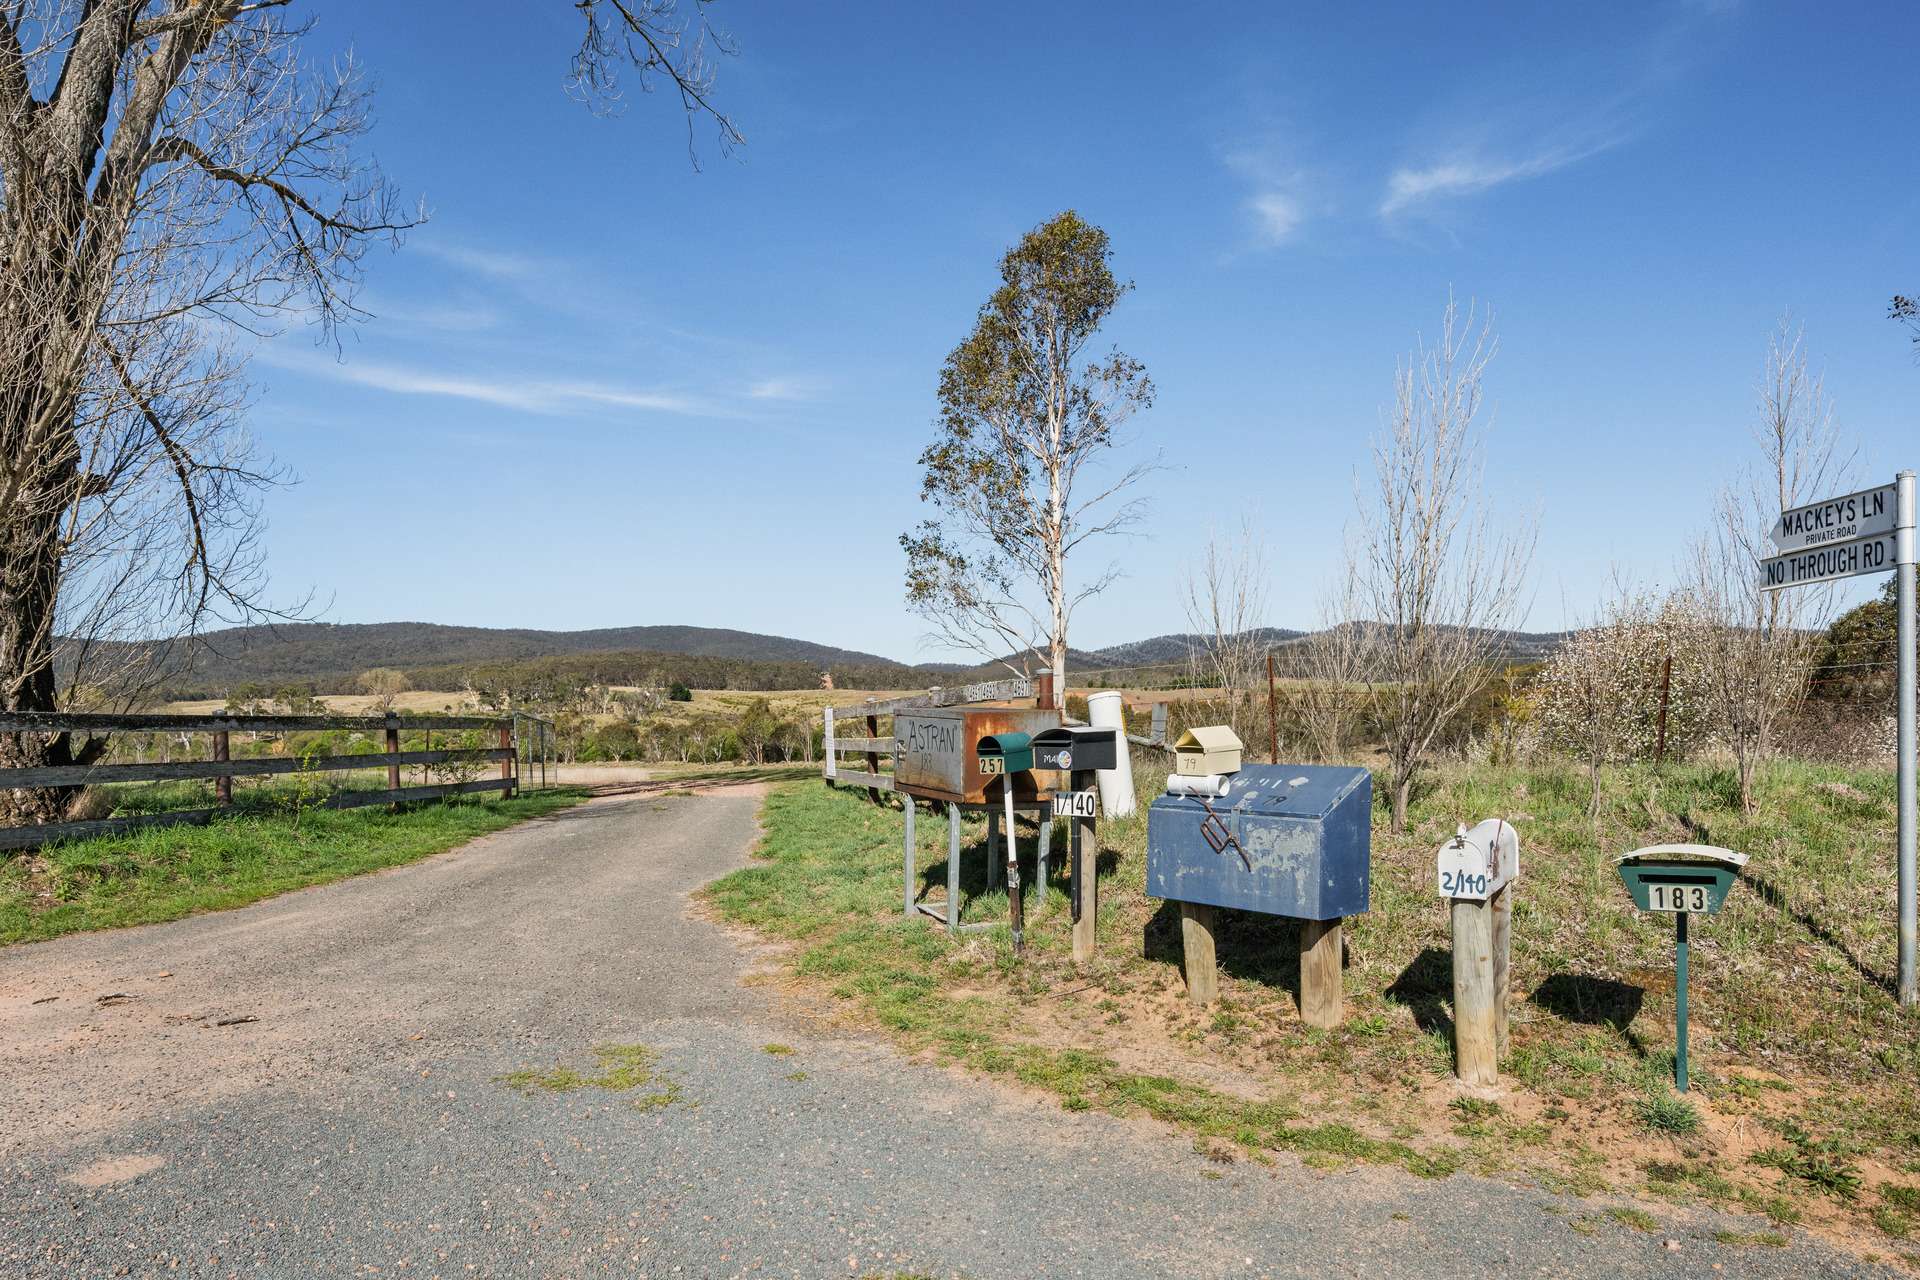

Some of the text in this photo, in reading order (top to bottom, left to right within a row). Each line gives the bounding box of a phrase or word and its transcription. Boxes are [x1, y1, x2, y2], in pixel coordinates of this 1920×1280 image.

[1782, 491, 1884, 538] MACKEYS LN
[1805, 524, 1857, 545] PRIVATE ROAD
[1767, 540, 1884, 586] NO THROUGH RD
[980, 757, 1003, 774] 257
[1184, 757, 1197, 770] 79
[1055, 793, 1095, 815] 1/140
[1442, 870, 1486, 897] 2/140
[1655, 886, 1704, 911] 183
